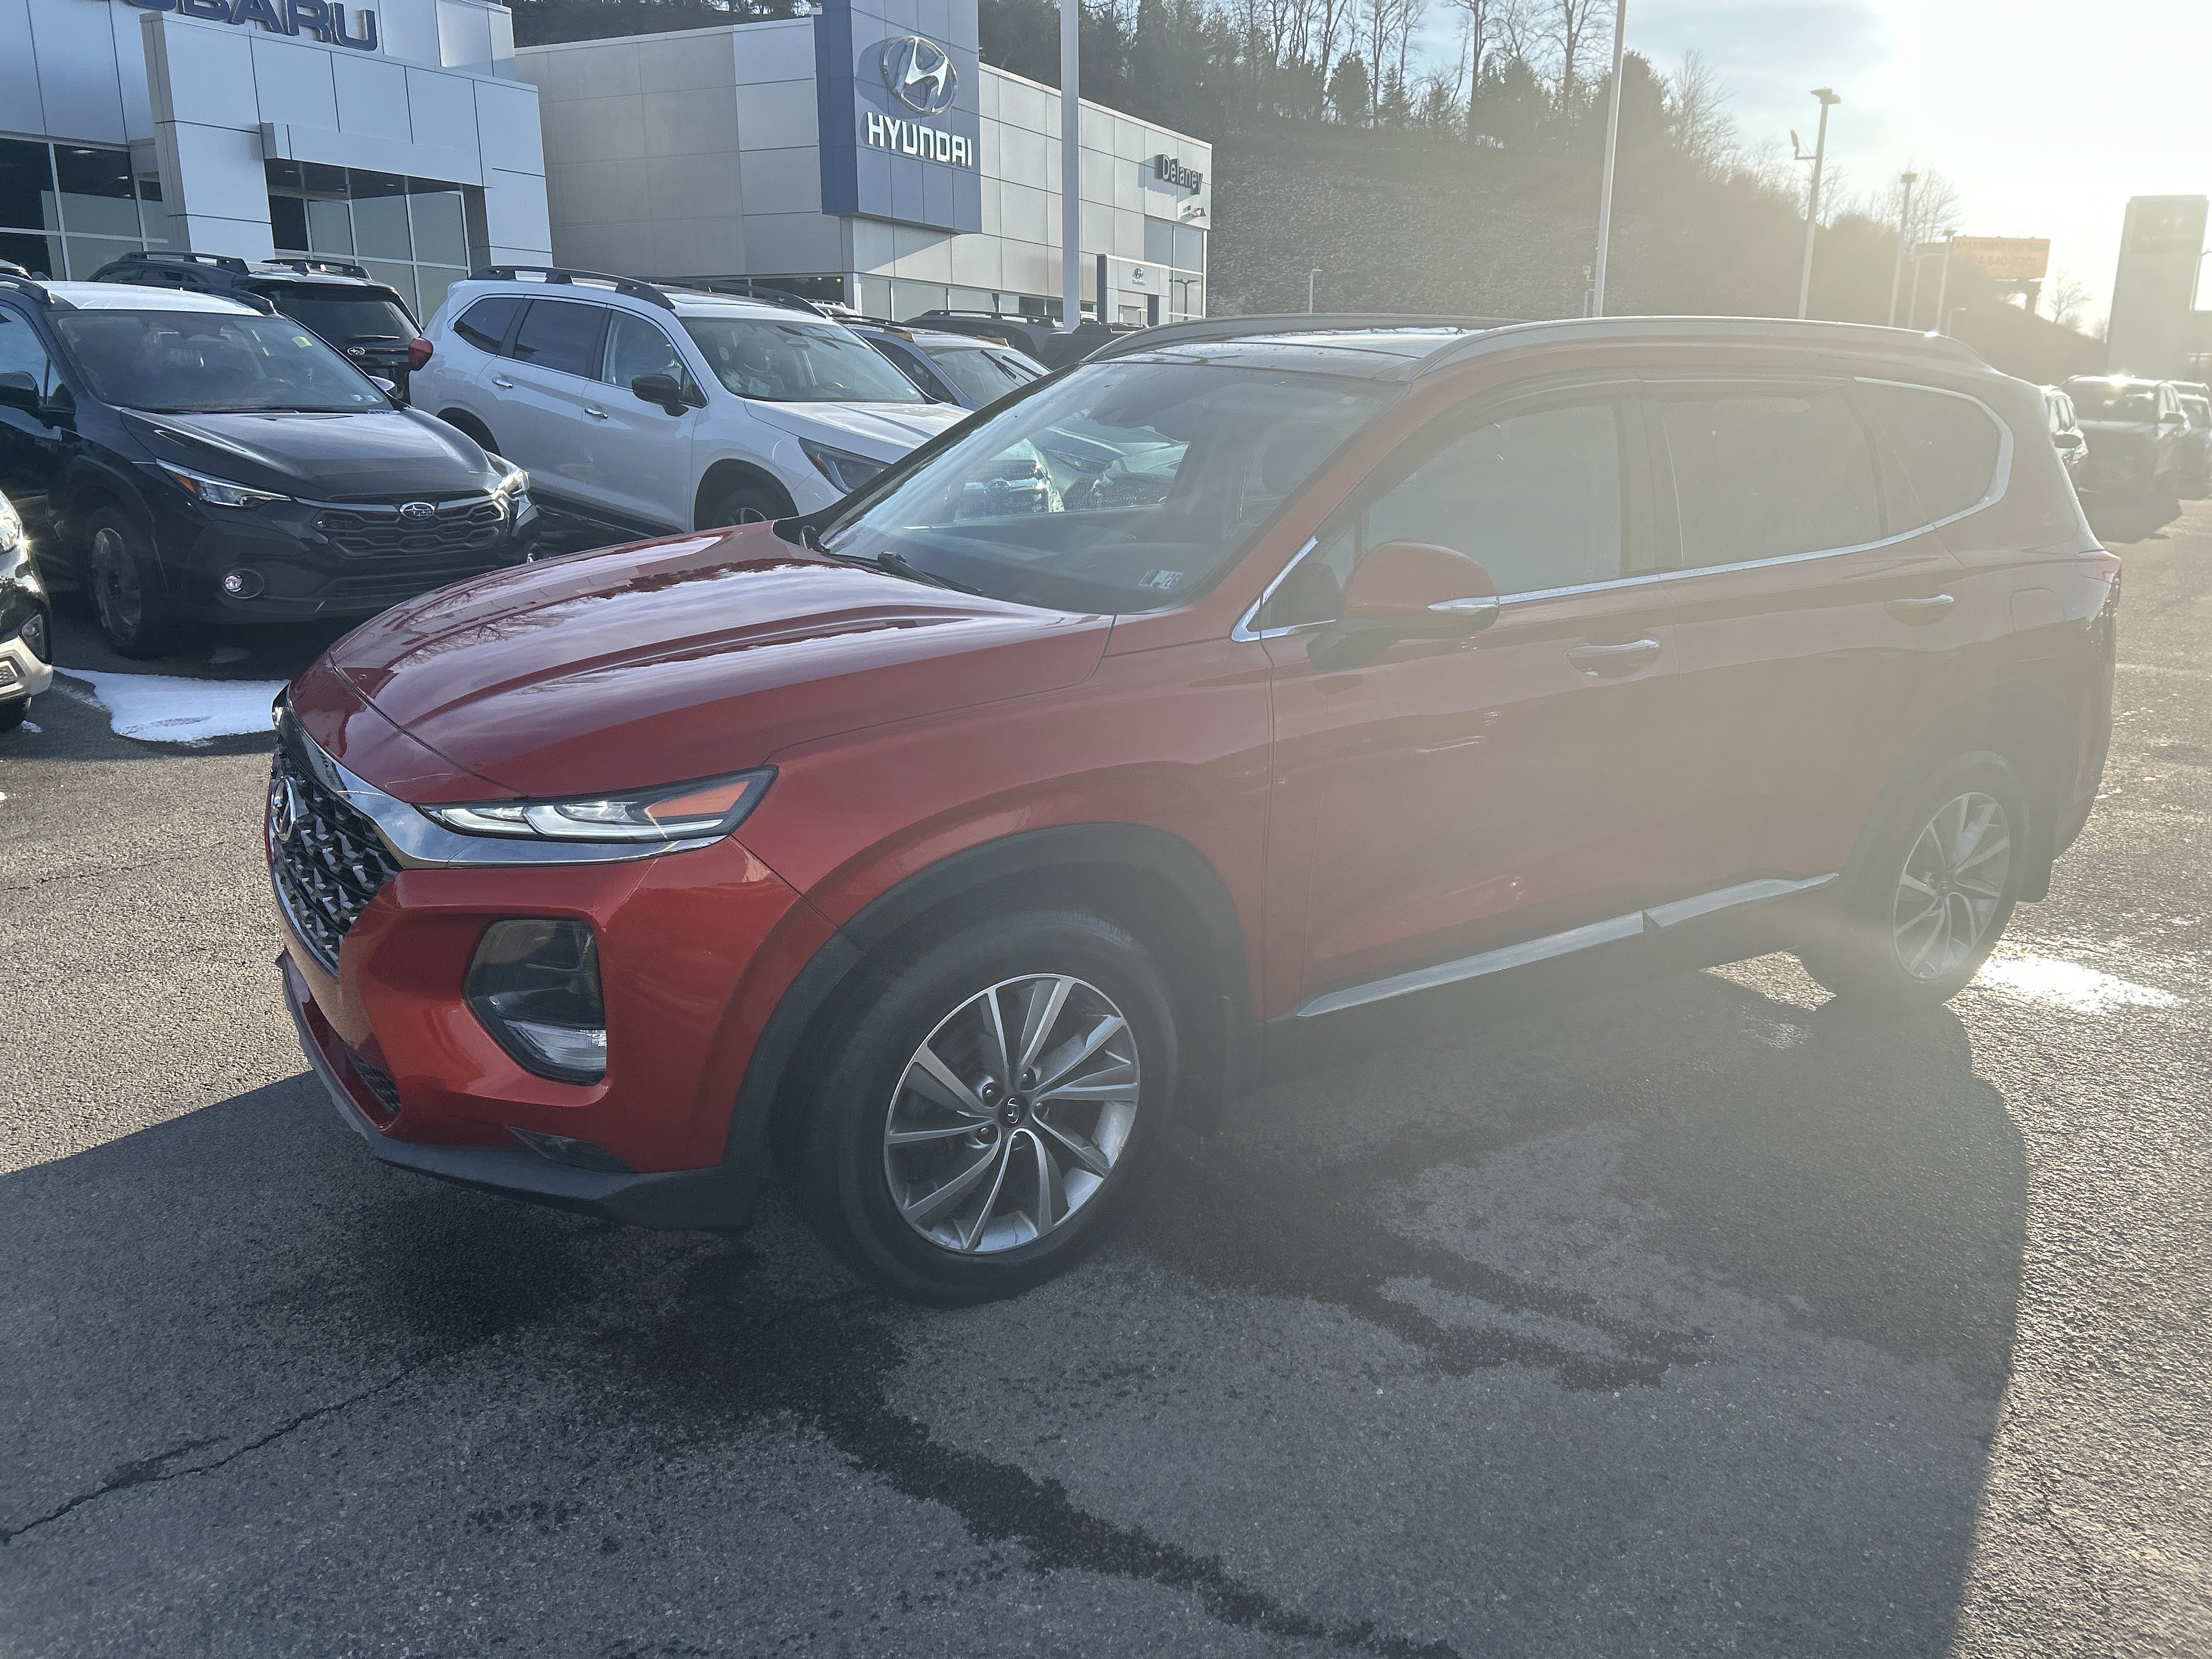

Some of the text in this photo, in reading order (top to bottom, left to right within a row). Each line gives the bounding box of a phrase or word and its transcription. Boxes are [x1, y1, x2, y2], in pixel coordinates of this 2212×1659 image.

[124, 0, 377, 51] BARU
[867, 111, 973, 168] HYUNDAI
[1162, 154, 1203, 195] Delaney
